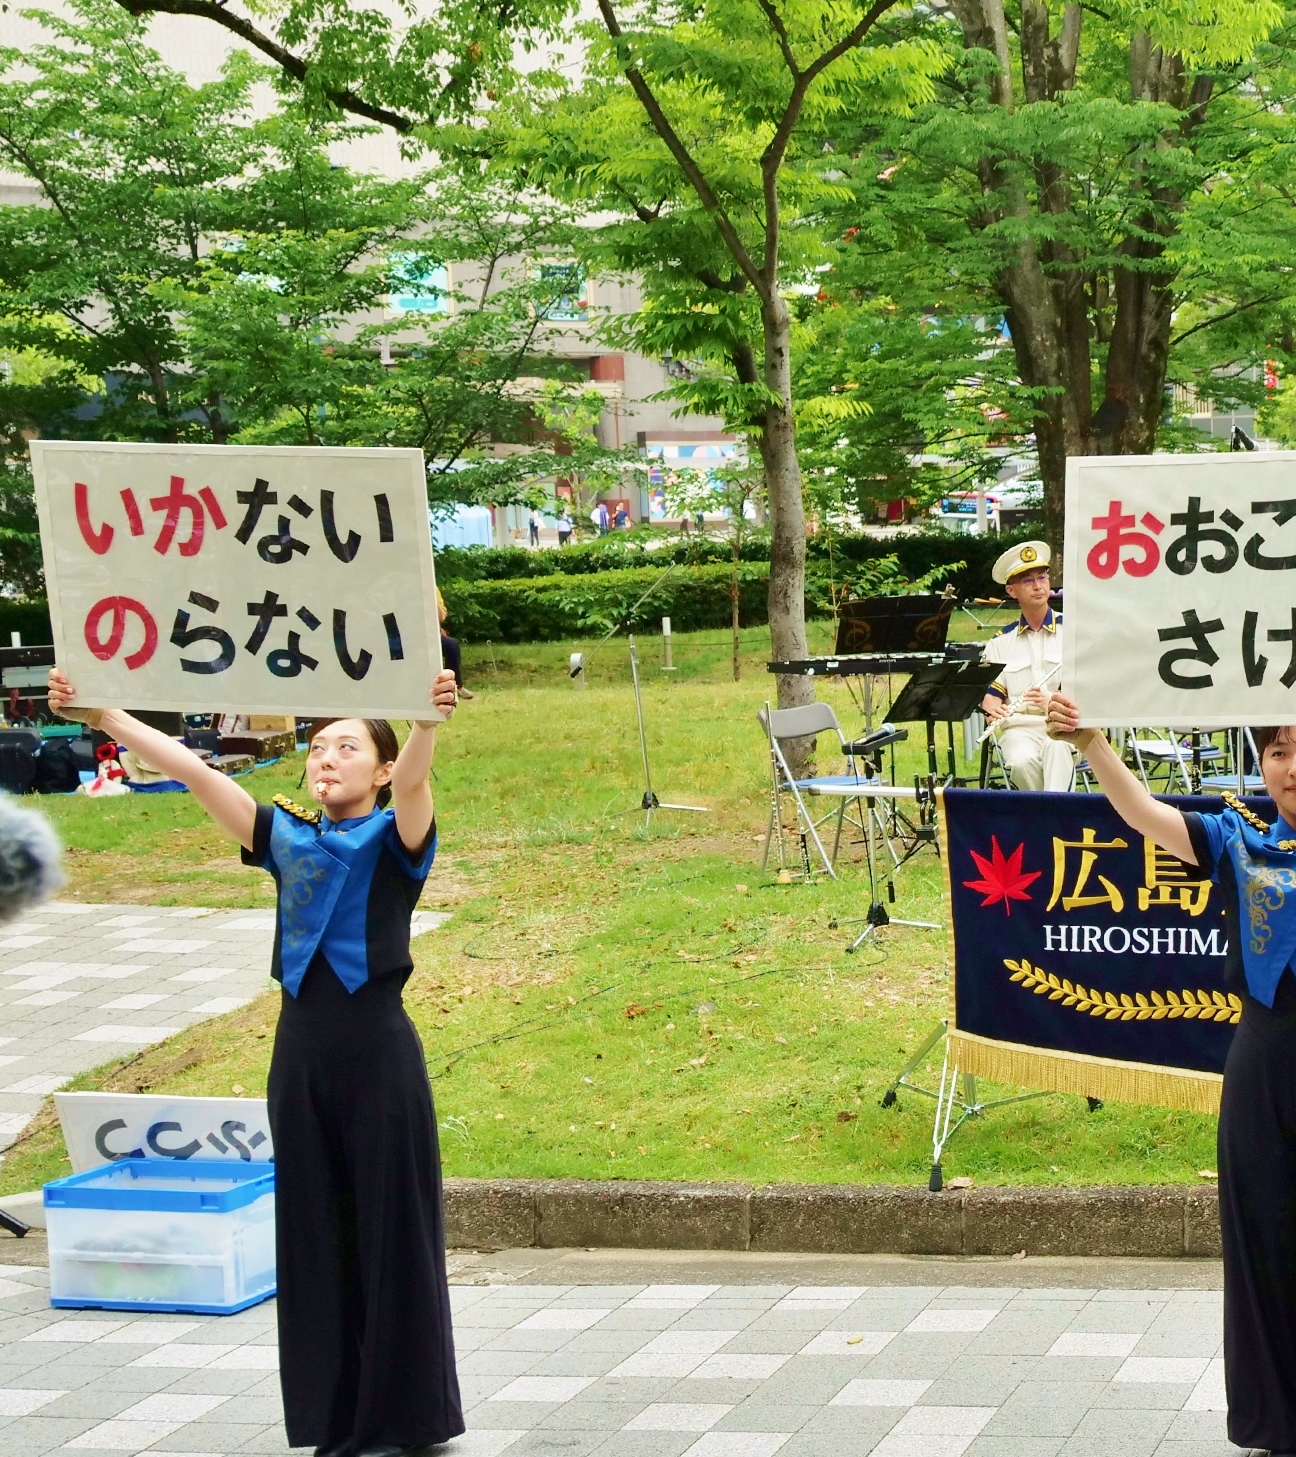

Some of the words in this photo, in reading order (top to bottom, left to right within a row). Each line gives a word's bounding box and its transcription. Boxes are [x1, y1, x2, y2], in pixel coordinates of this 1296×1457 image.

[75, 476, 393, 564] いかない
[84, 590, 404, 680] のらない
[1043, 925, 1229, 955] HIROSHIM
